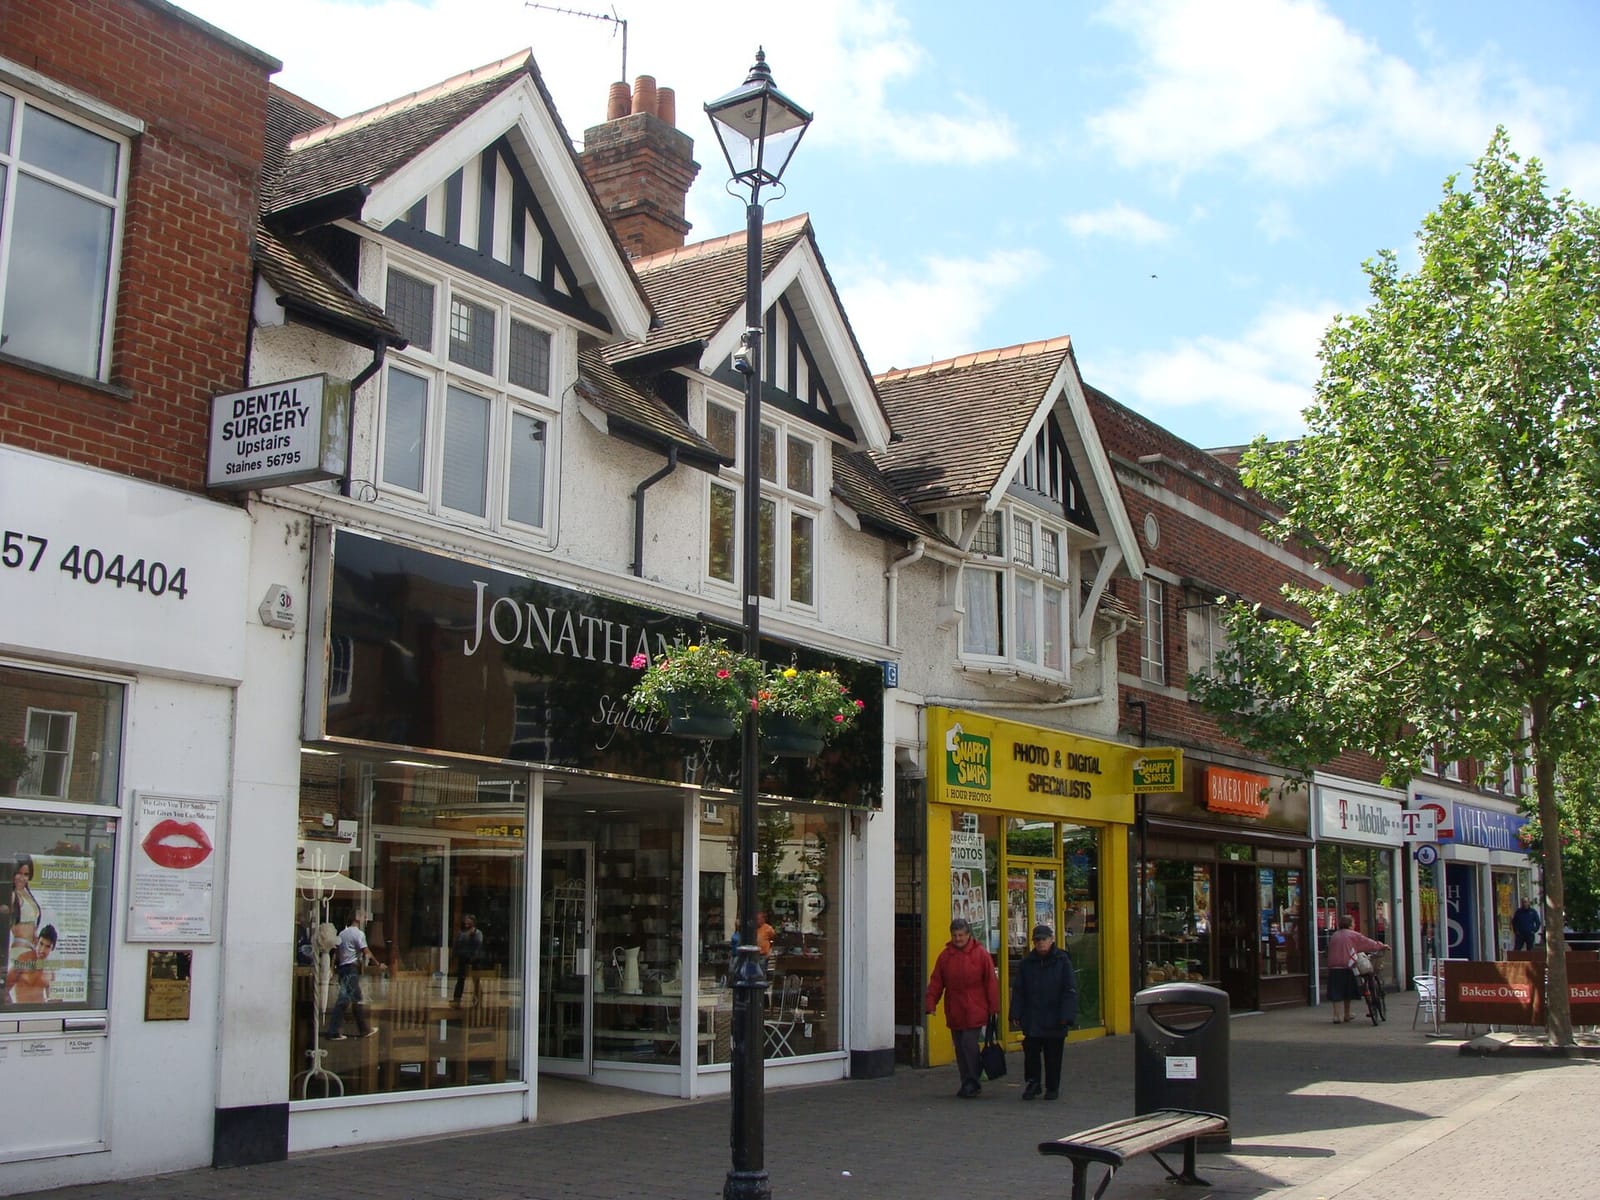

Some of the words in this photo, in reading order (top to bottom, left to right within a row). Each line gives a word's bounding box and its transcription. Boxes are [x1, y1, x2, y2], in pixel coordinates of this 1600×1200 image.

[233, 388, 302, 419] DENTAL
[222, 406, 310, 441] SURGERY
[236, 434, 291, 458] Upstairs
[225, 460, 263, 475] Staines
[266, 451, 301, 468] 56795
[2, 530, 48, 572] 57
[60, 545, 188, 600] 404404
[592, 695, 657, 750] Stylish
[952, 735, 988, 765] SNAPPY
[1013, 742, 1050, 766] PHOTO
[1054, 750, 1062, 768] &
[1067, 752, 1102, 775] DIGITAL
[958, 761, 988, 785] SNAPS
[1138, 760, 1172, 776] SNAPPY
[1143, 774, 1171, 784] SNAPS
[945, 788, 949, 798] 1
[950, 789, 968, 801] HOUR
[968, 791, 992, 803] PHOTOS
[1028, 772, 1092, 800] SPECIALISTS
[1212, 775, 1241, 803] BAKERS
[1458, 806, 1511, 850] WHSmith
[41, 869, 89, 881] Liposuction
[1461, 986, 1497, 997] Bakers
[1498, 987, 1528, 998] Oven
